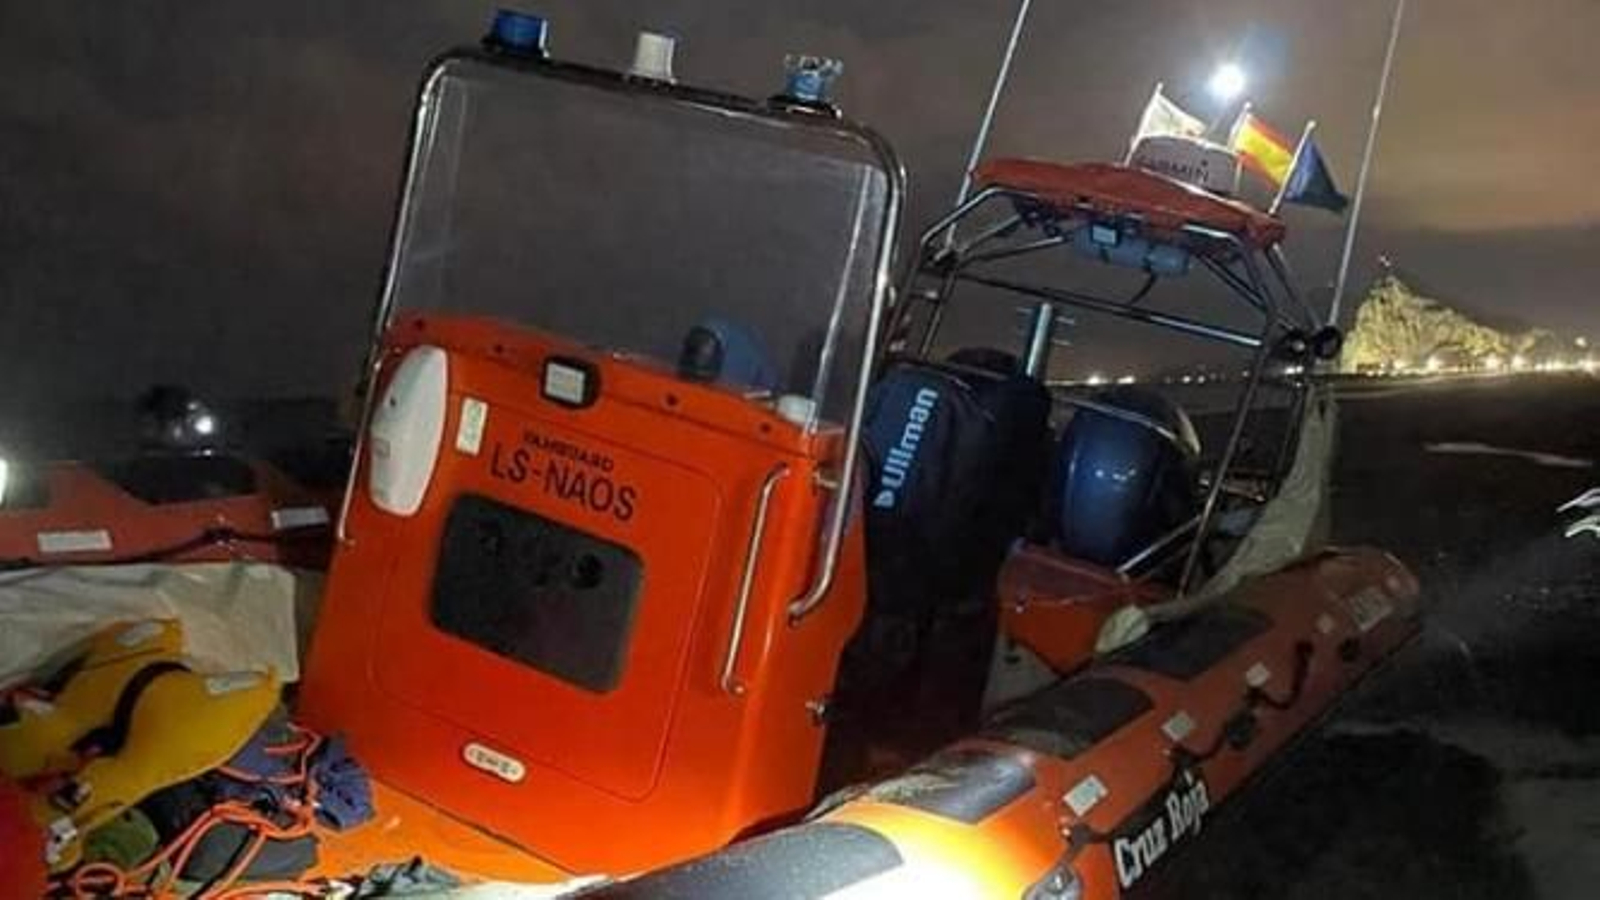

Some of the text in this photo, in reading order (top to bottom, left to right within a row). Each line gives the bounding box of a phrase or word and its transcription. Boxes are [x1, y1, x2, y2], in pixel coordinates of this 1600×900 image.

[491, 442, 637, 521] LS-NAOS
[881, 387, 939, 488] Ullman
[1114, 769, 1210, 888] Cruz Roja
